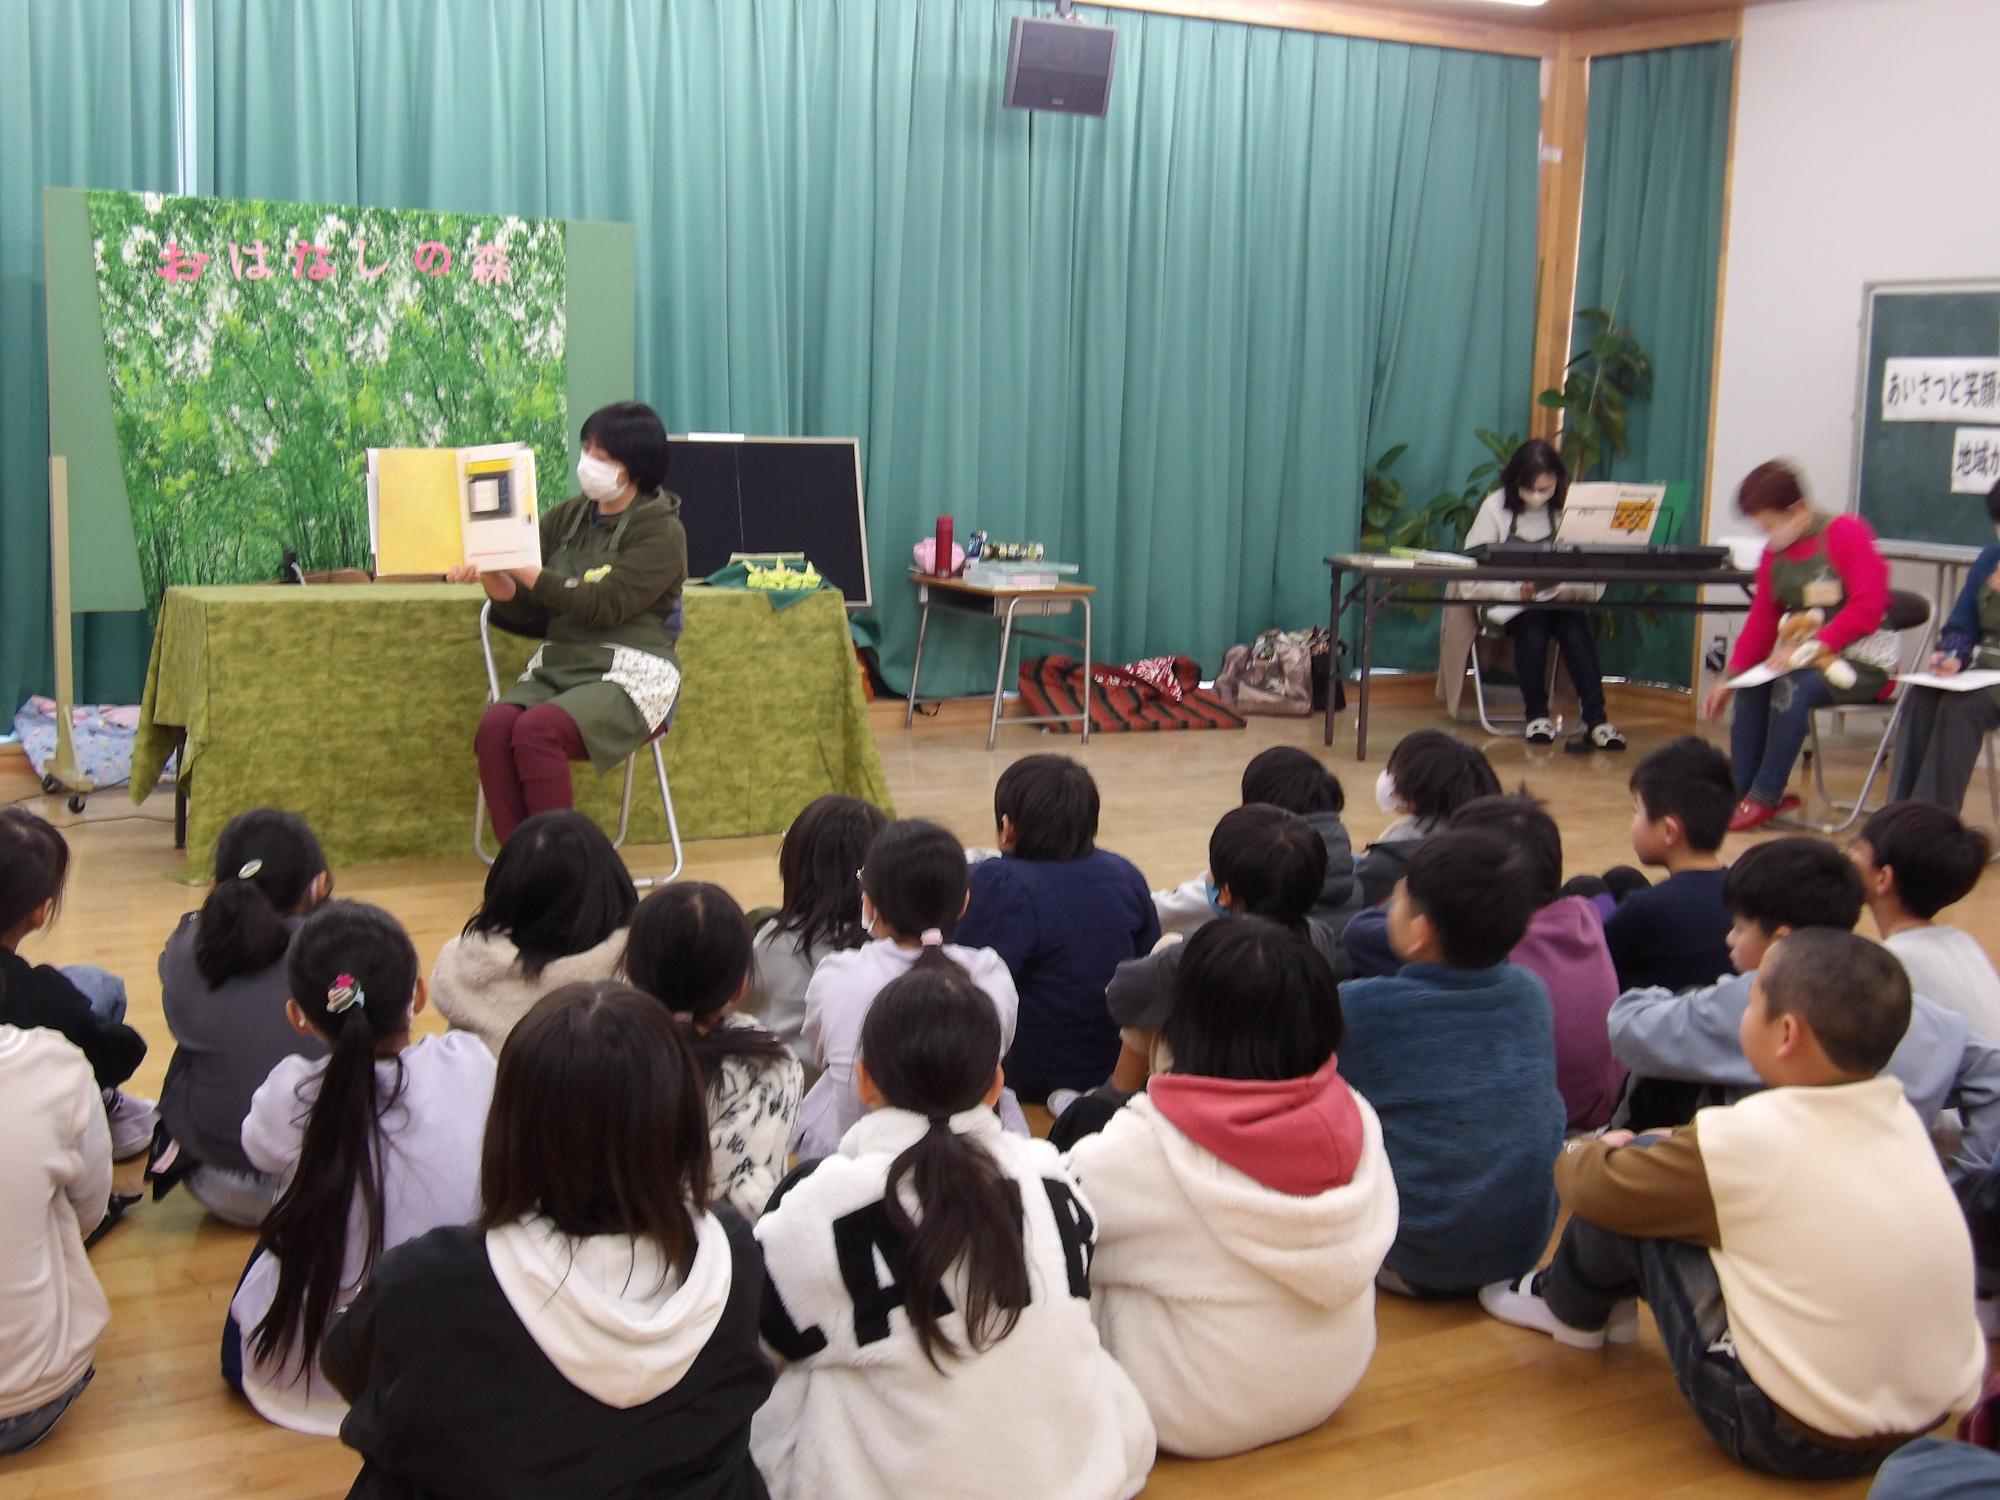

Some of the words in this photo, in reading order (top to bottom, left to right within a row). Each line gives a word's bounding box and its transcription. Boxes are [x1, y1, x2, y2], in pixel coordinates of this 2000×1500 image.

[156, 239, 512, 285] おはなしの森
[1887, 370, 2000, 408] あいさつと笑顔
